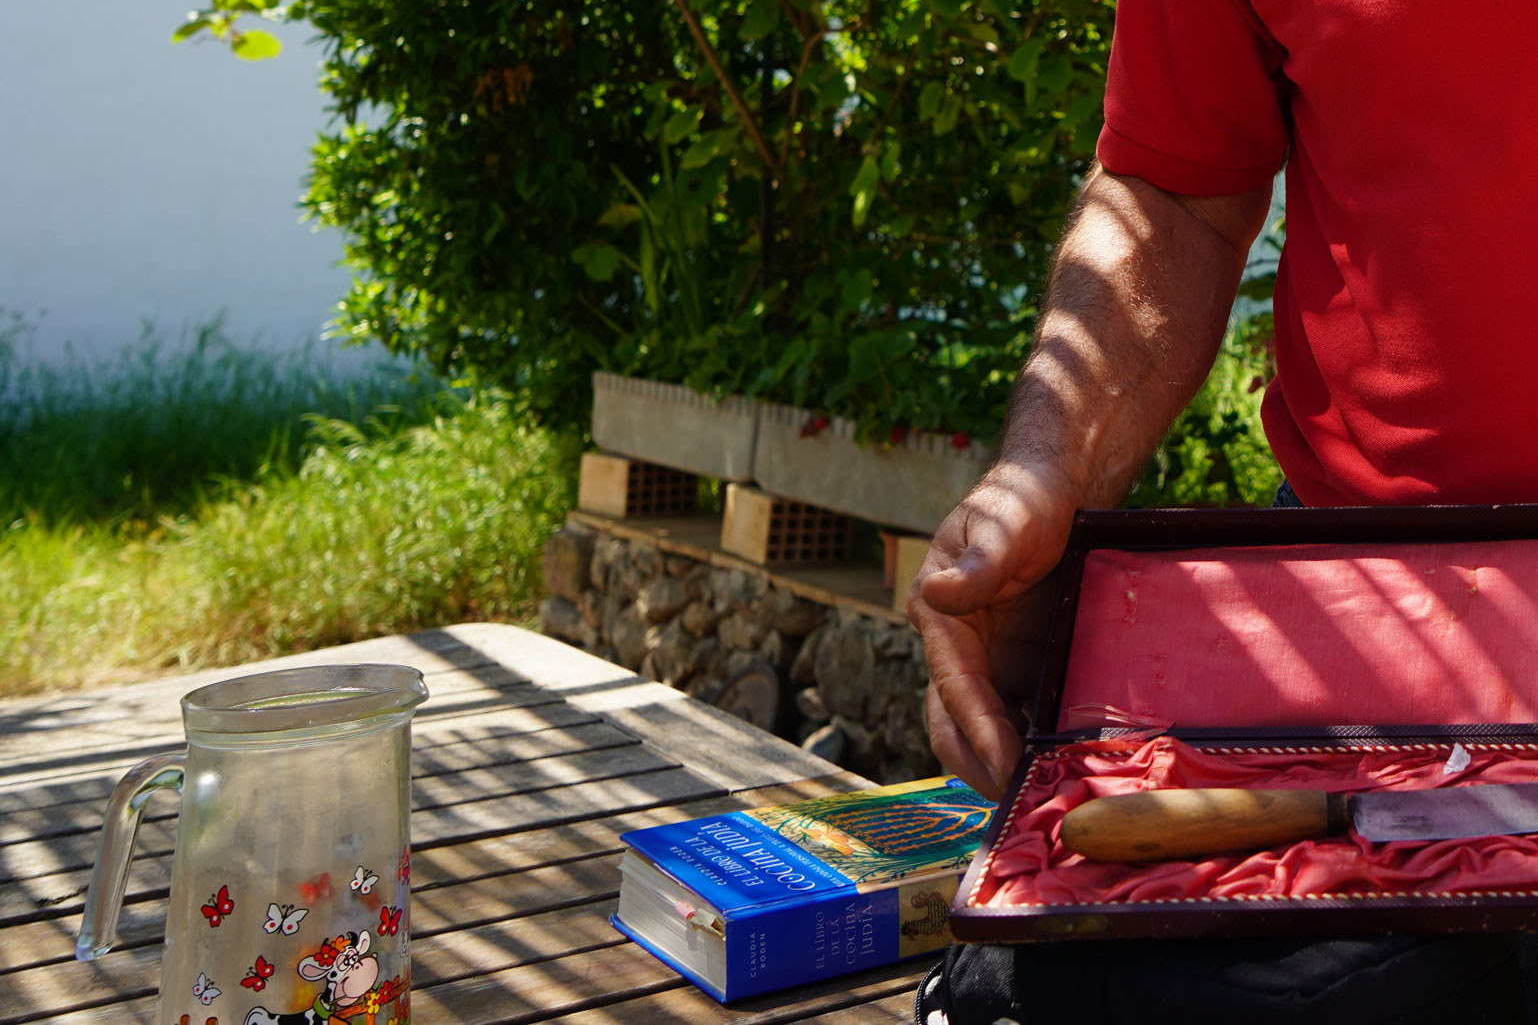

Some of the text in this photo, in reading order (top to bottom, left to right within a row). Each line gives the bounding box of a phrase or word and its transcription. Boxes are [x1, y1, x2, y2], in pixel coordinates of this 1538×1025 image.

[670, 846, 727, 885] CLAUDIA RODEN
[685, 836, 765, 887] EL LIBRO DE LA
[815, 911, 825, 969] EL LIBRO
[831, 918, 840, 955] DE LA
